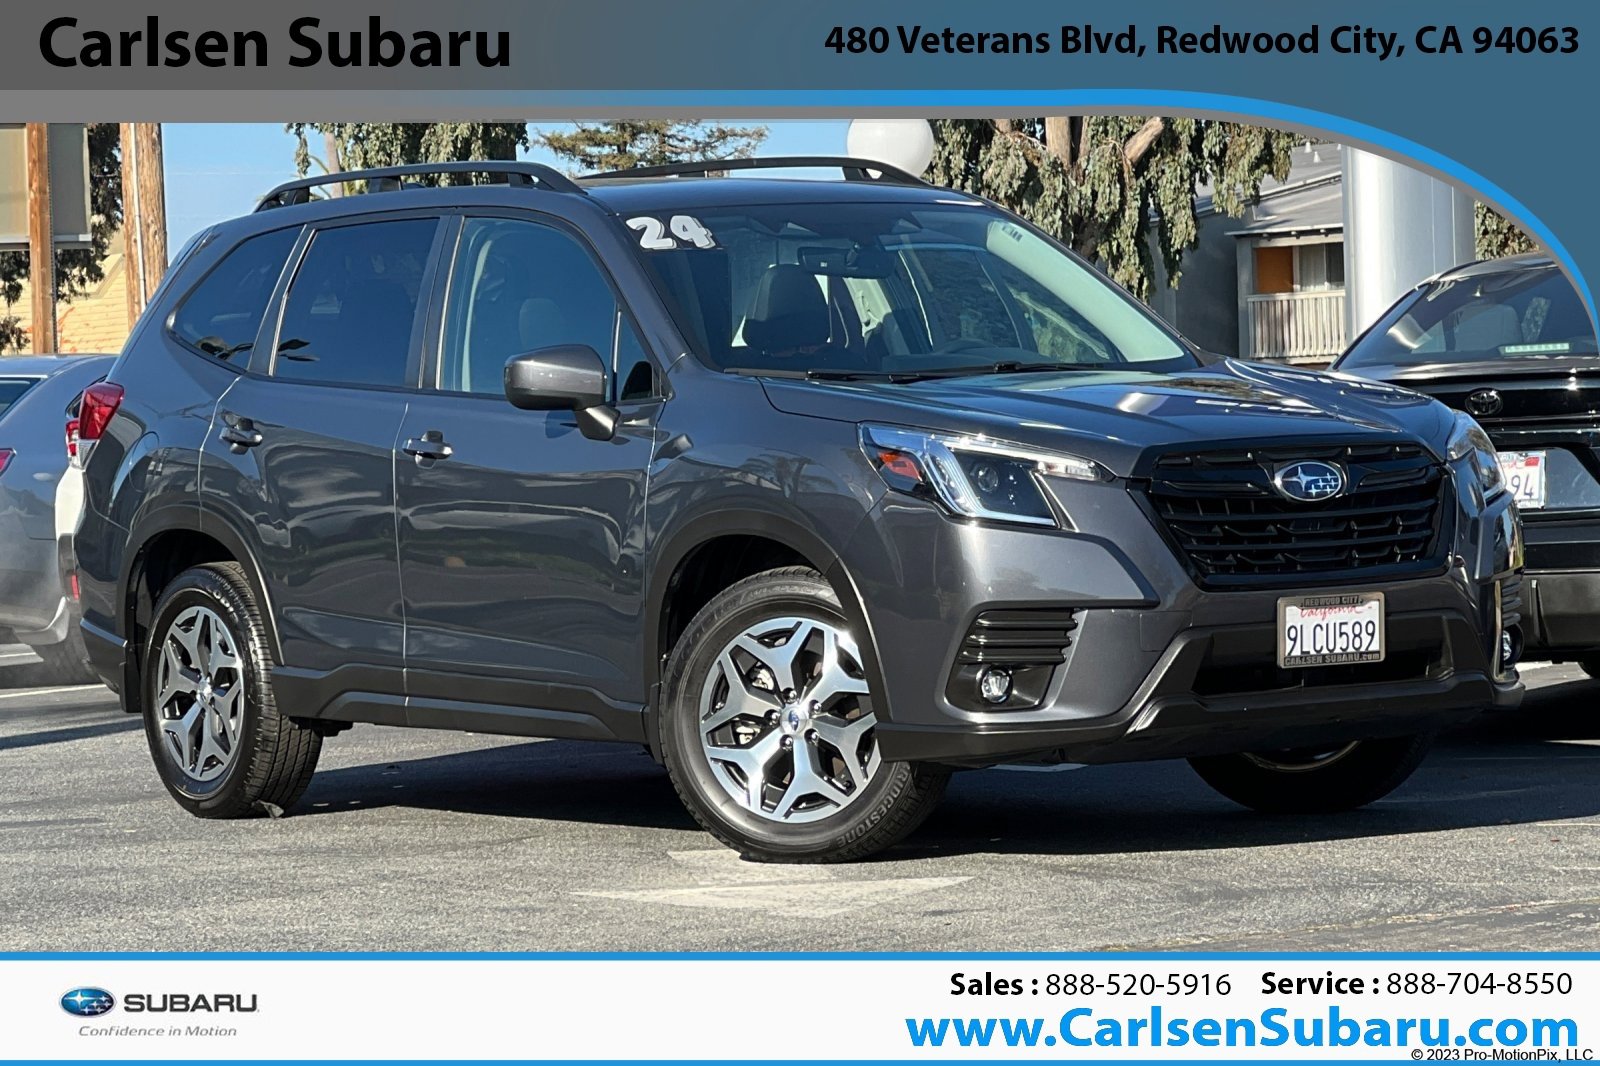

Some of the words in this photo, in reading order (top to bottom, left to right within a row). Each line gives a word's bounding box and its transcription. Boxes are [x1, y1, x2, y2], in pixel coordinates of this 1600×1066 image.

[625, 215, 716, 250] 24
[1305, 597, 1340, 607] REDWOOD
[1342, 595, 1358, 605] CITY
[1287, 620, 1376, 656] 9LCU589
[1284, 654, 1321, 666] CARLSEN
